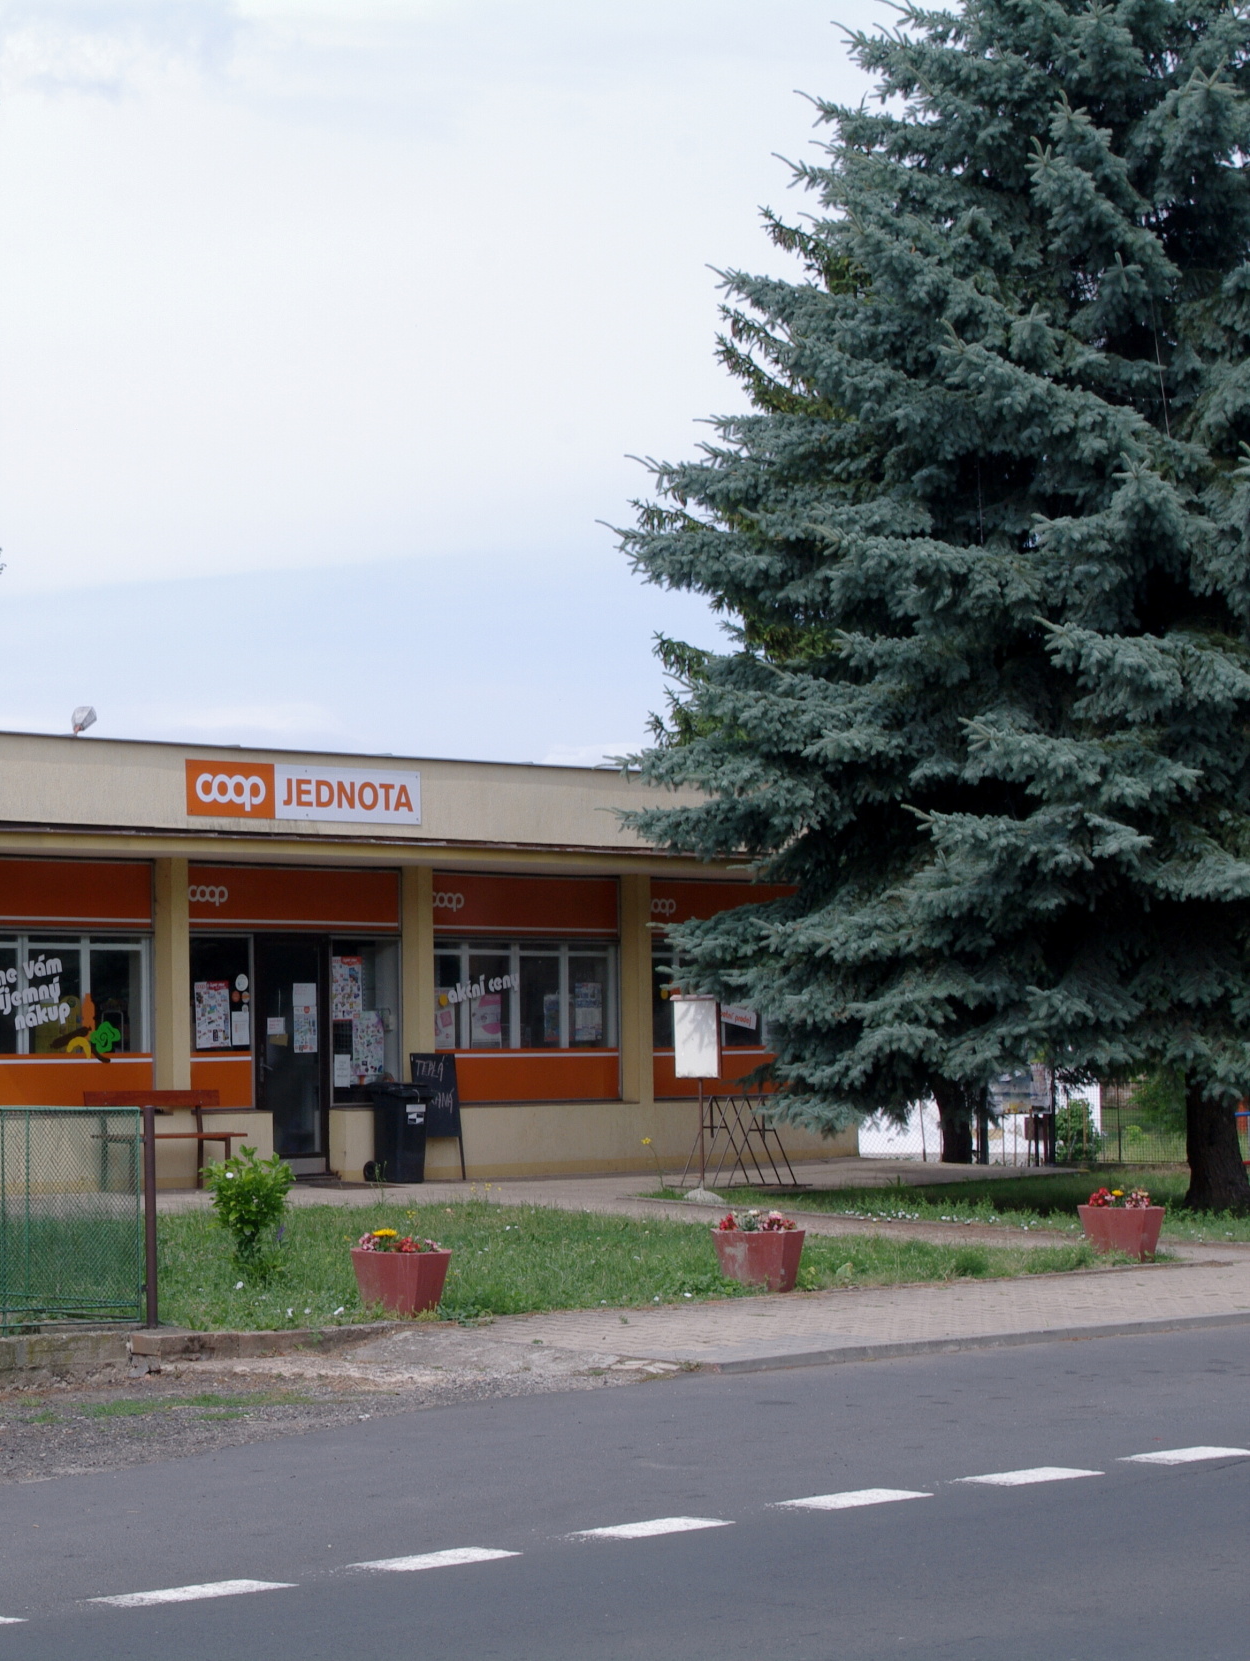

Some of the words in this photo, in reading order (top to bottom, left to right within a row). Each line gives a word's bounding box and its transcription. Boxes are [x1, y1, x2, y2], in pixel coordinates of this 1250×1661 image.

[195, 773, 266, 812] coop
[282, 778, 414, 812] JEDNOTA
[188, 885, 229, 907] coop
[651, 898, 677, 917] oop
[22, 954, 63, 980] Vám
[447, 974, 486, 1004] akční
[488, 971, 520, 993] ceny
[14, 1002, 71, 1031] nákup
[415, 1055, 446, 1082] TEPLÁ
